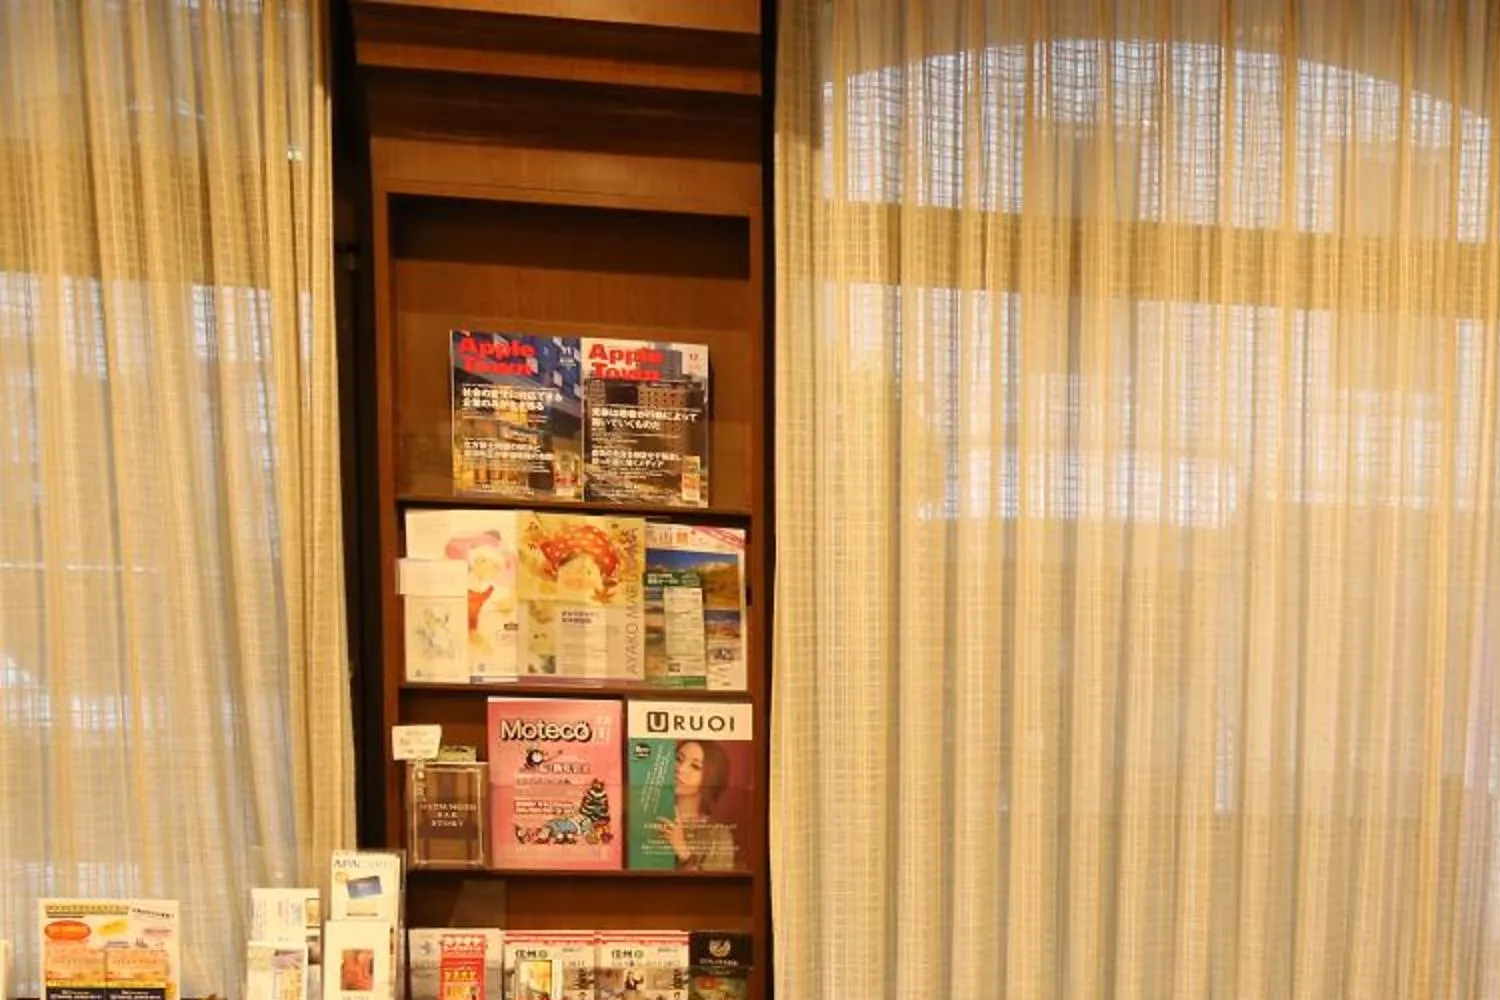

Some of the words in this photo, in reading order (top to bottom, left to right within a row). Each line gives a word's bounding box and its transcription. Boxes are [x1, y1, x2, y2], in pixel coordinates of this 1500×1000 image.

[458, 337, 539, 361] Apple
[589, 343, 663, 365] Apple
[591, 361, 661, 381] Town
[500, 718, 593, 743] Moteco
[647, 711, 736, 733] URUOI
